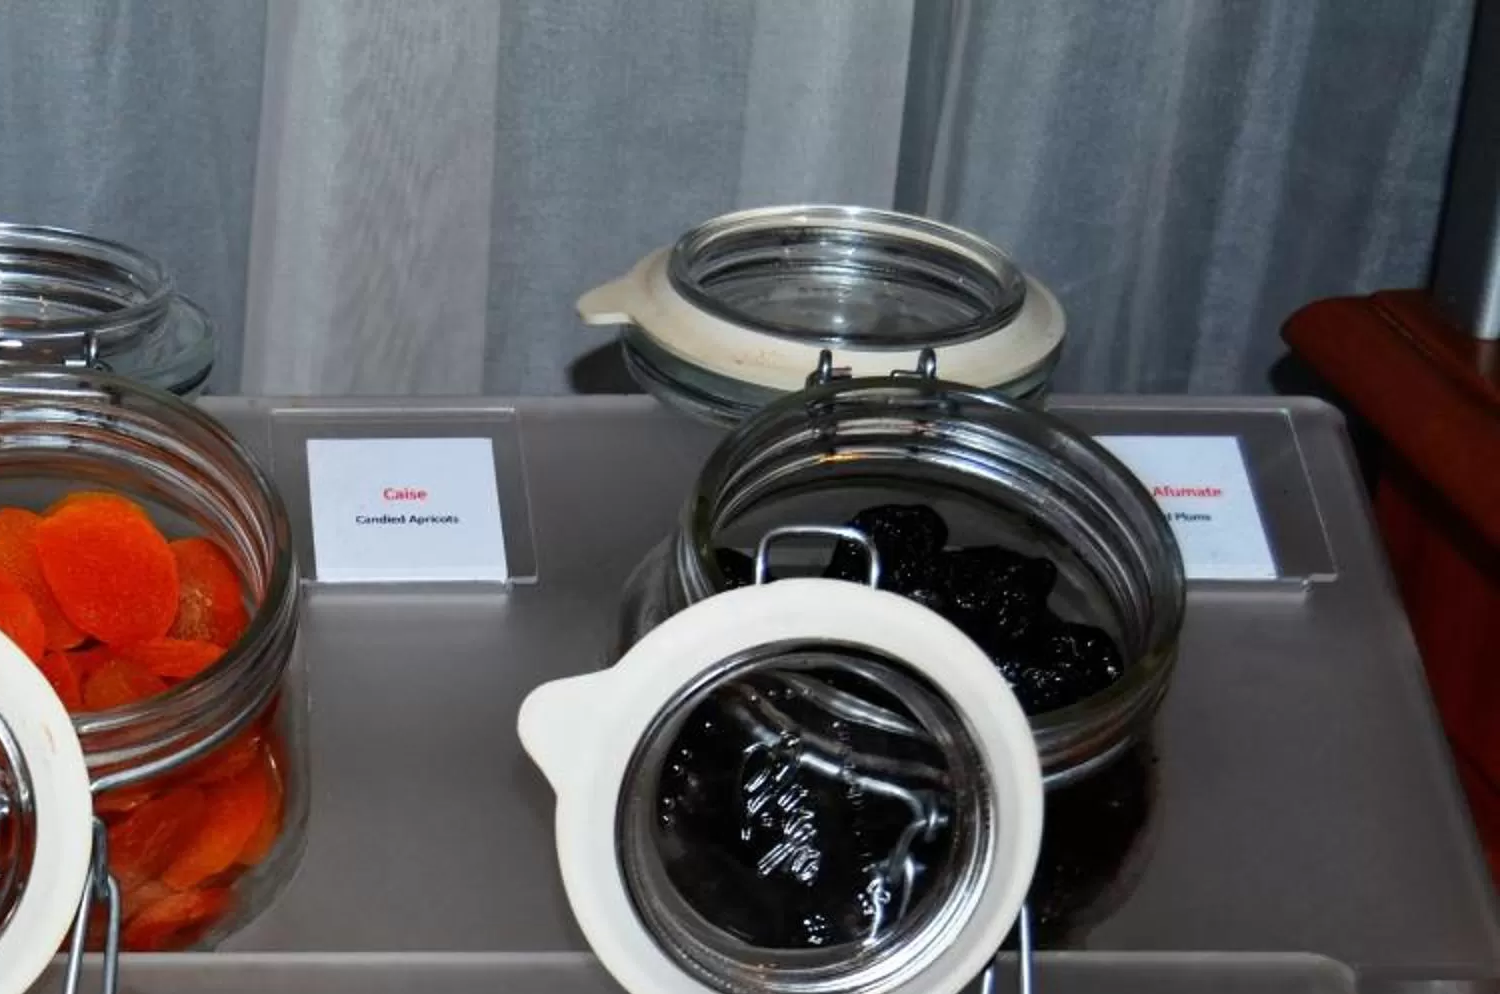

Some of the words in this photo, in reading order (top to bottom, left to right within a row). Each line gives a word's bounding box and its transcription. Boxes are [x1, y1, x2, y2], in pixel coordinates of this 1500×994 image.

[383, 488, 428, 501] Caise
[1153, 486, 1223, 497] Afumate
[356, 514, 406, 524] Candied
[409, 514, 459, 525] Apricots
